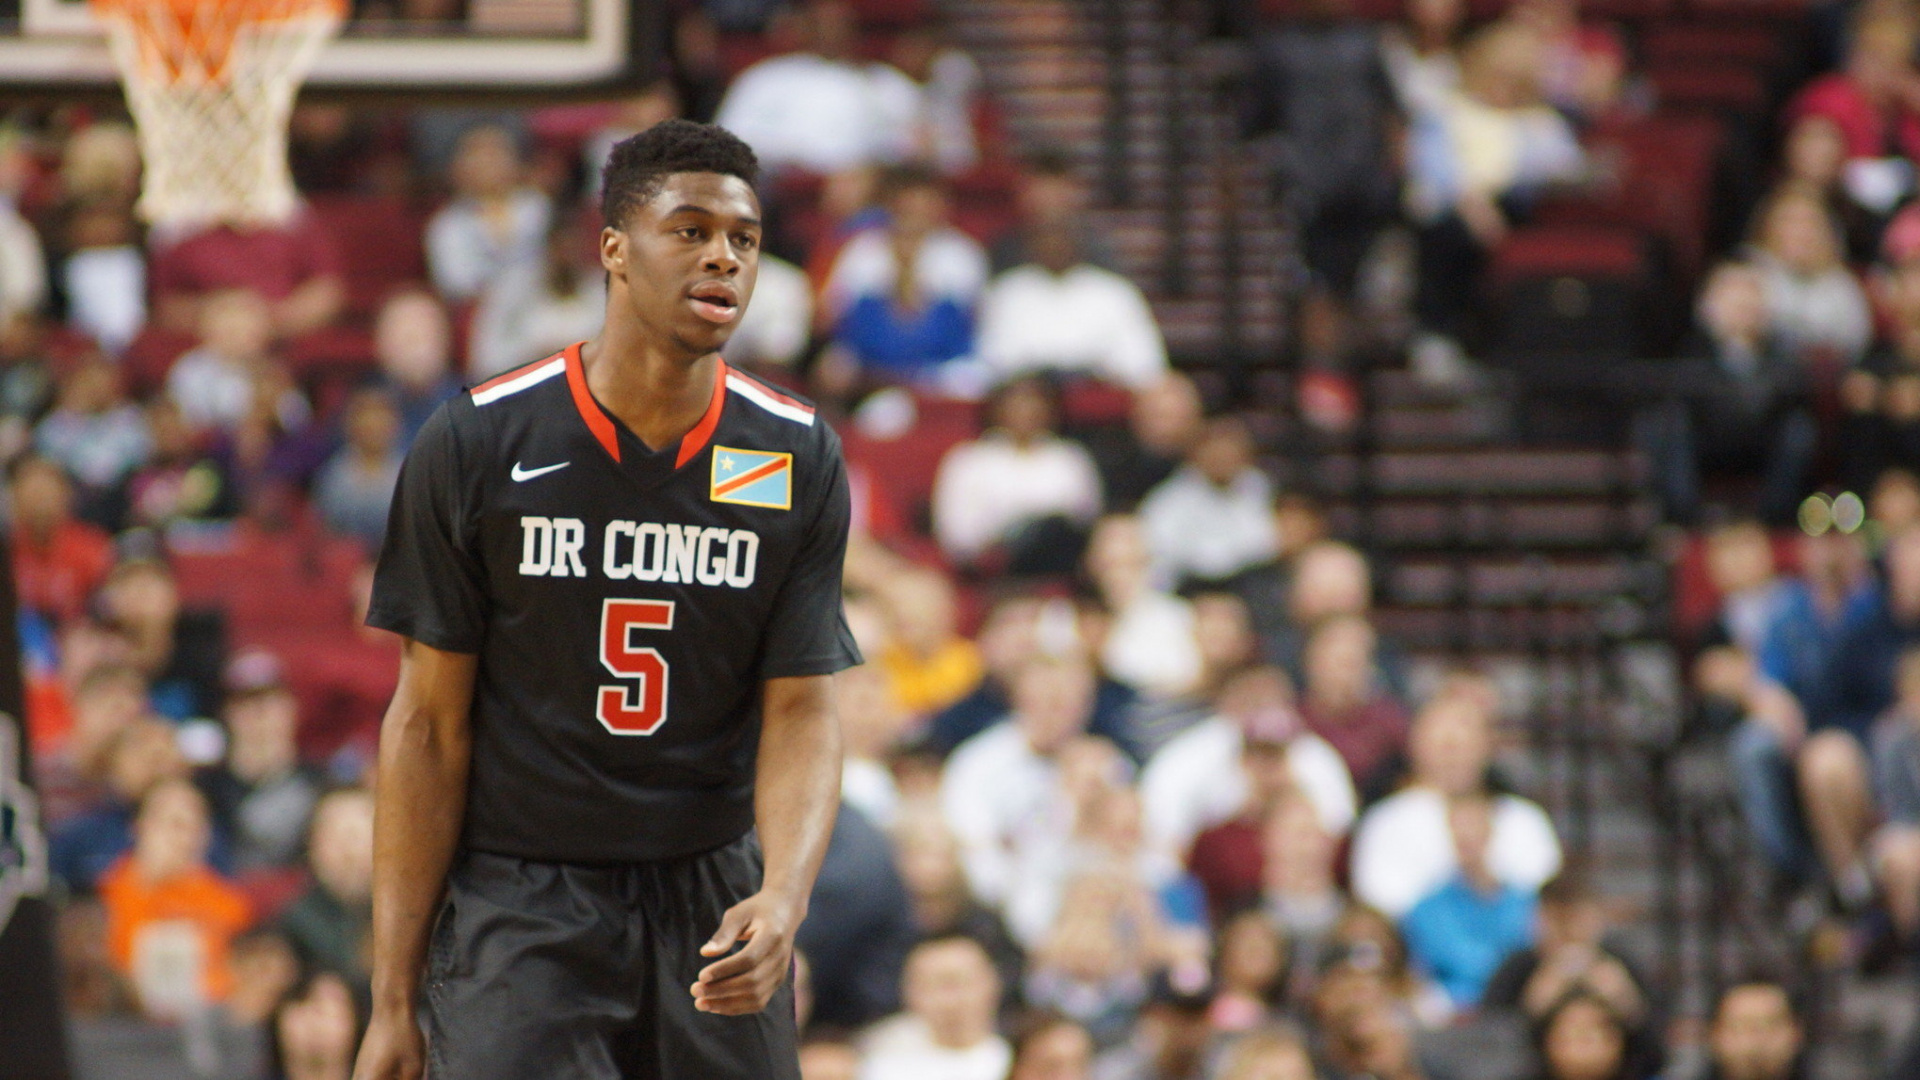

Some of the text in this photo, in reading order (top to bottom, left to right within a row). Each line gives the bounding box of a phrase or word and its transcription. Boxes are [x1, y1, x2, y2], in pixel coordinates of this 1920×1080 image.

[519, 516, 760, 589] DR CONGO
[596, 598, 675, 736] 5
